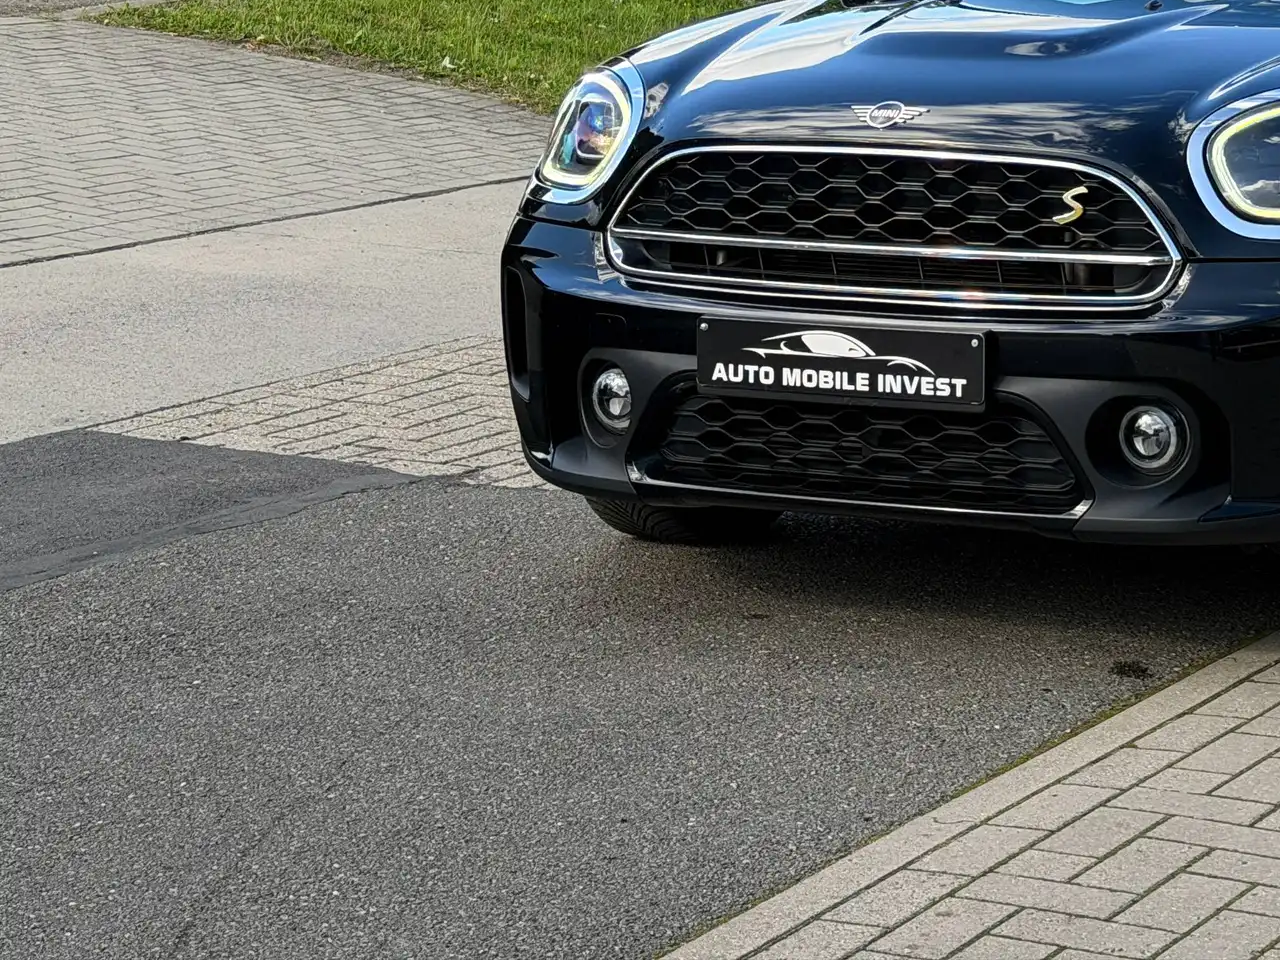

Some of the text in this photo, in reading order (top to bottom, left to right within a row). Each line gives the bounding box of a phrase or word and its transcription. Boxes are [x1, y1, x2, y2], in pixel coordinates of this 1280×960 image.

[871, 108, 900, 118] MINI
[711, 362, 968, 398] AUTO MOBILE INVEST
